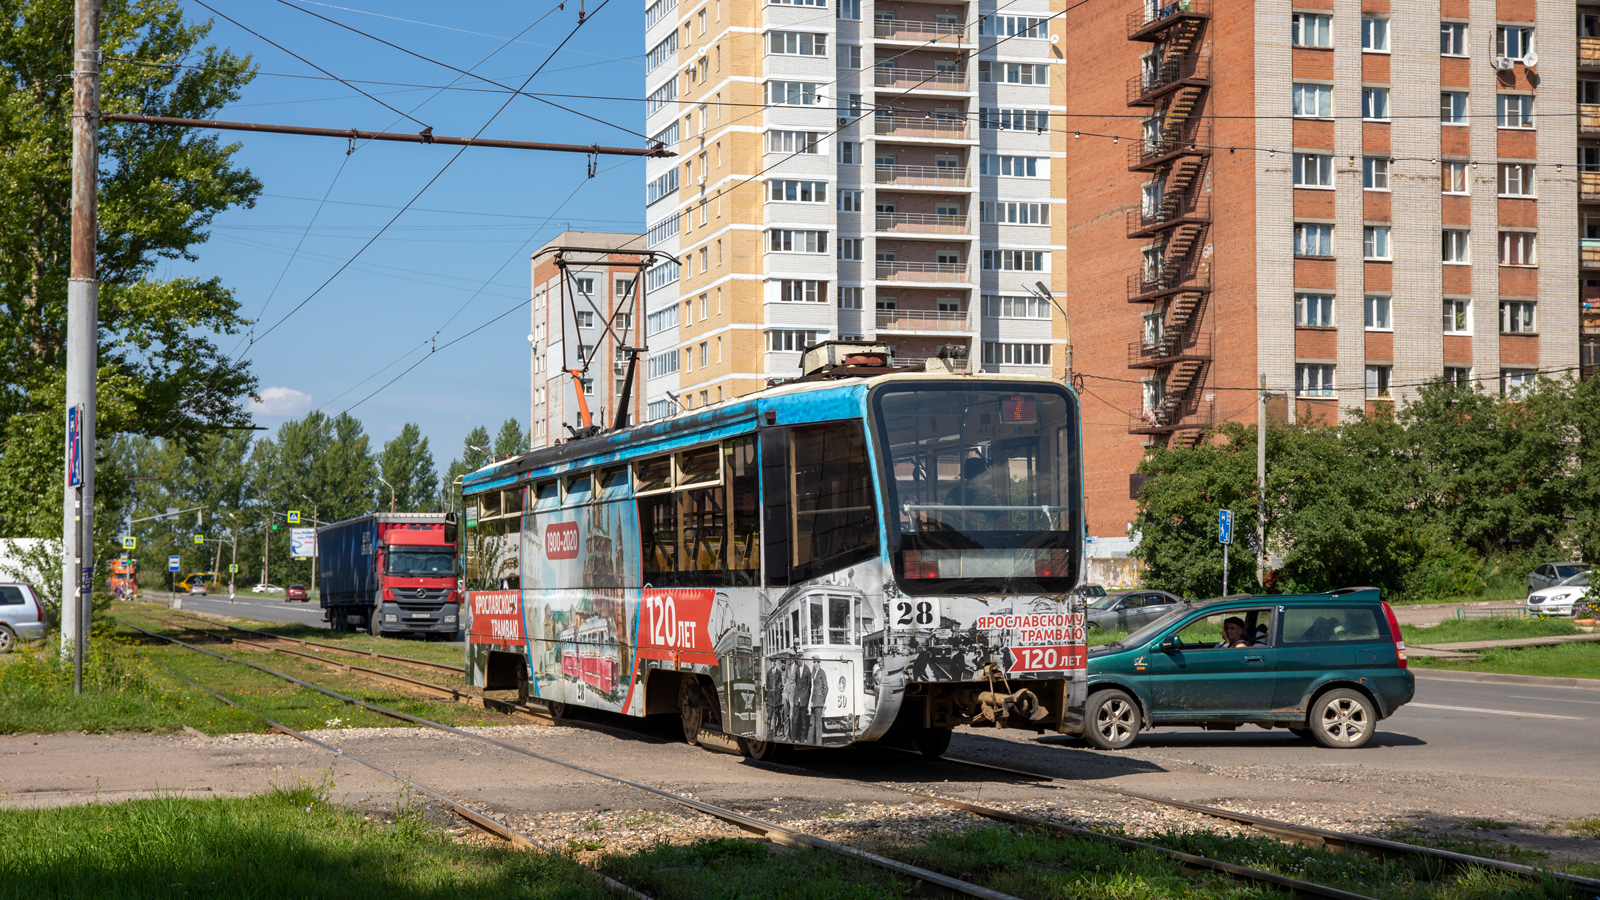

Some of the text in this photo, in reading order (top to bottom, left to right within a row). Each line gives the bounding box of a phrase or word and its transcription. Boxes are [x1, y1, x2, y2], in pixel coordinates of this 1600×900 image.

[1010, 395, 1025, 420] 7
[547, 529, 578, 553] 1900-2020
[475, 594, 518, 615] ЯРОСЛАВСКОМУ
[897, 601, 933, 625] 28
[491, 619, 519, 641] ТРАМВАЮ
[646, 596, 696, 649] 120 ЛЕТ
[977, 613, 1084, 629] ЯРОСЛАВСКОМУ
[1020, 628, 1083, 642] ТРАМВАЮ
[1021, 648, 1082, 669] 120 ЛЕТ
